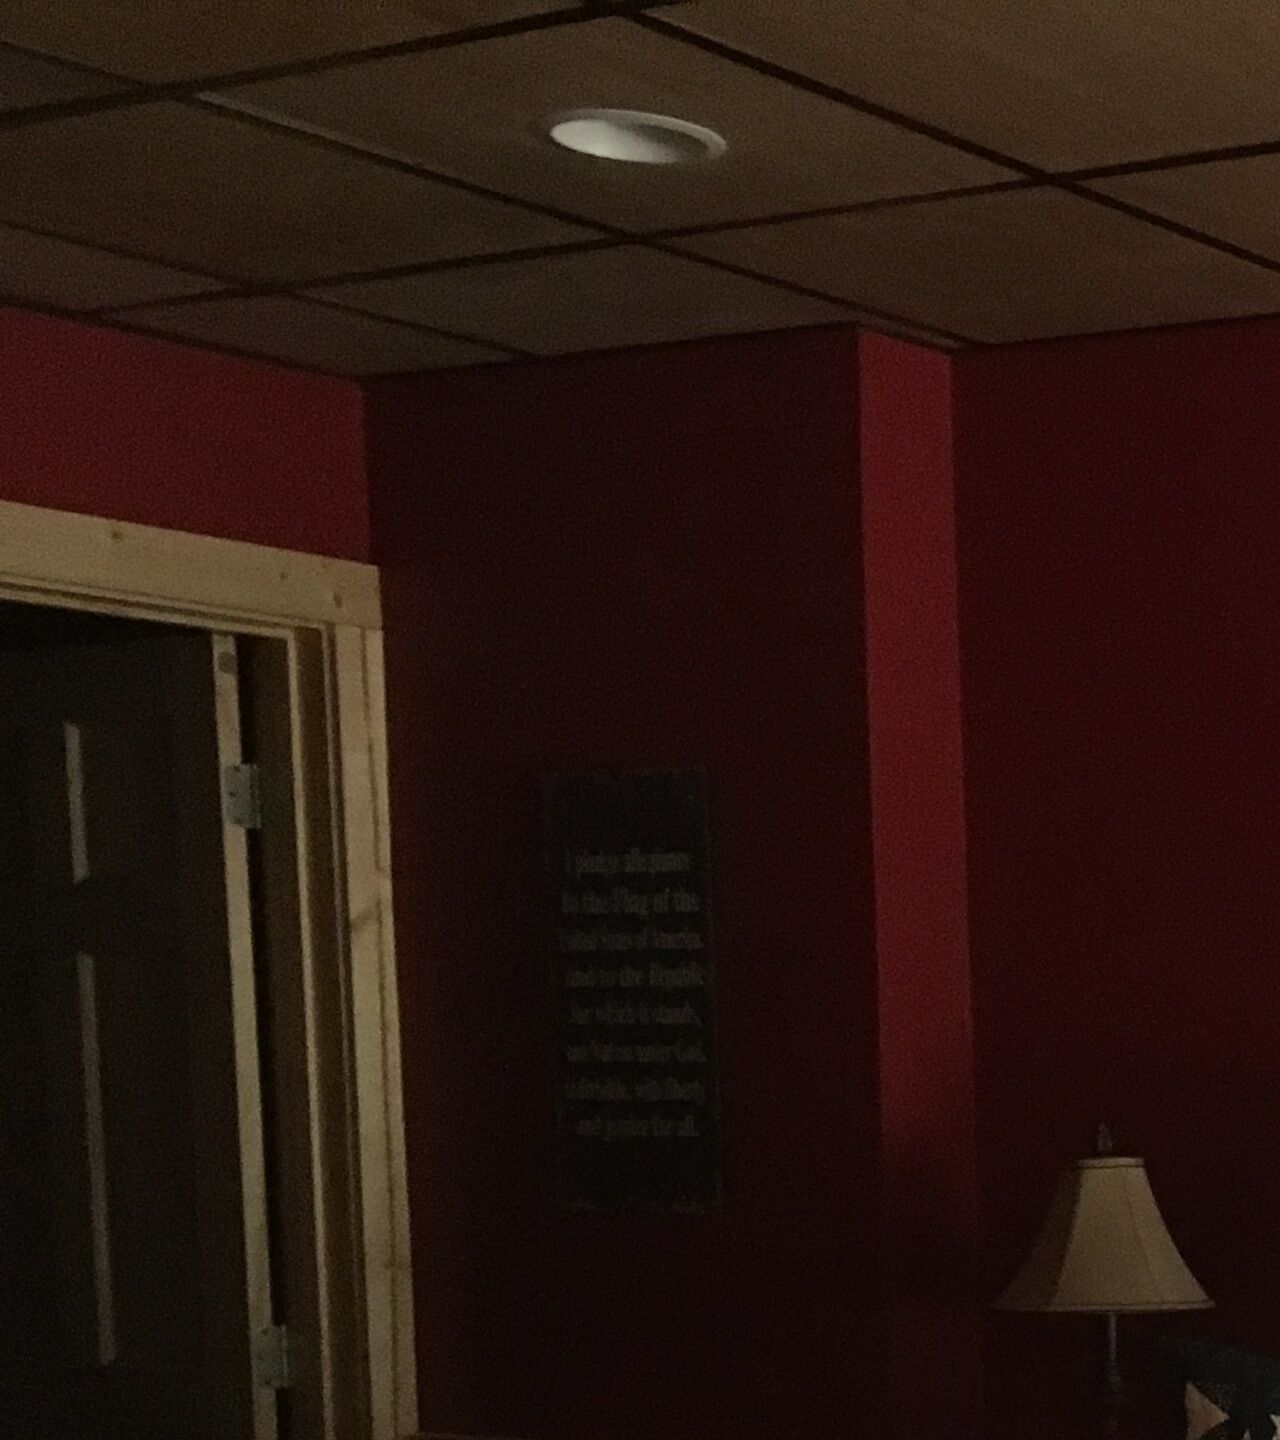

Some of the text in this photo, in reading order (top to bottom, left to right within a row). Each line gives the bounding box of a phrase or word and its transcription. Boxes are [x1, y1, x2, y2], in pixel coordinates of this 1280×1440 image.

[653, 887, 670, 913] of
[672, 887, 700, 913] the
[619, 965, 644, 987] the
